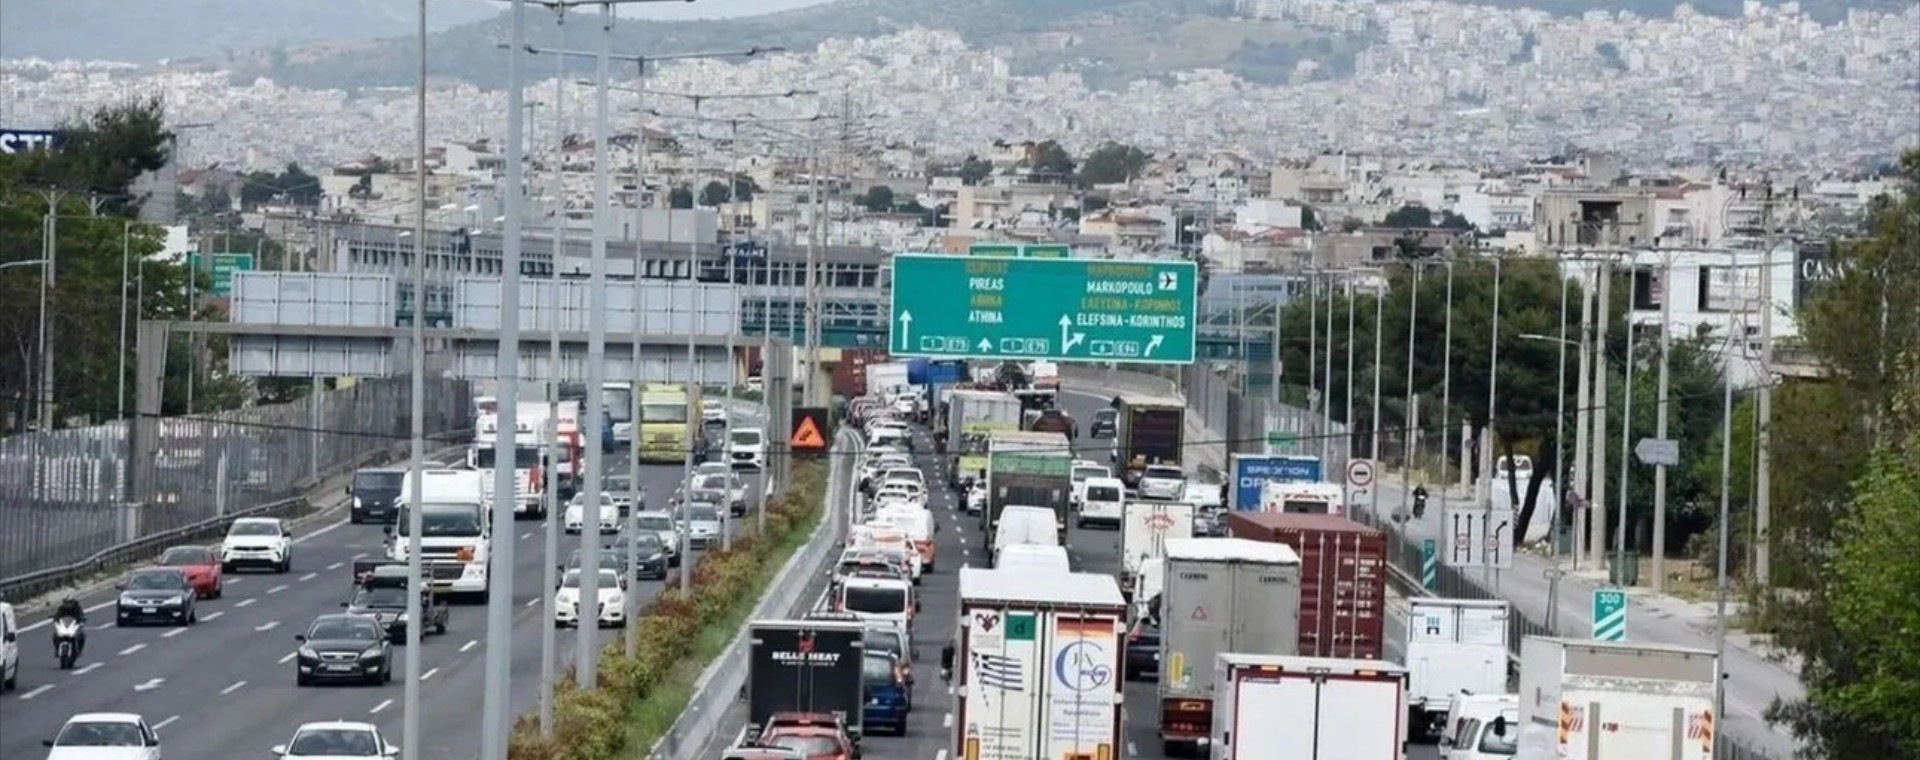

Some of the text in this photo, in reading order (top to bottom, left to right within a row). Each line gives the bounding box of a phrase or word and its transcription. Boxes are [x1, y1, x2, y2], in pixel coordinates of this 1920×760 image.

[969, 277, 1004, 291] PIREAS
[1087, 281, 1153, 295] MARKOPOULO
[968, 310, 1003, 324] ATHINA
[1600, 594, 1620, 604] 300
